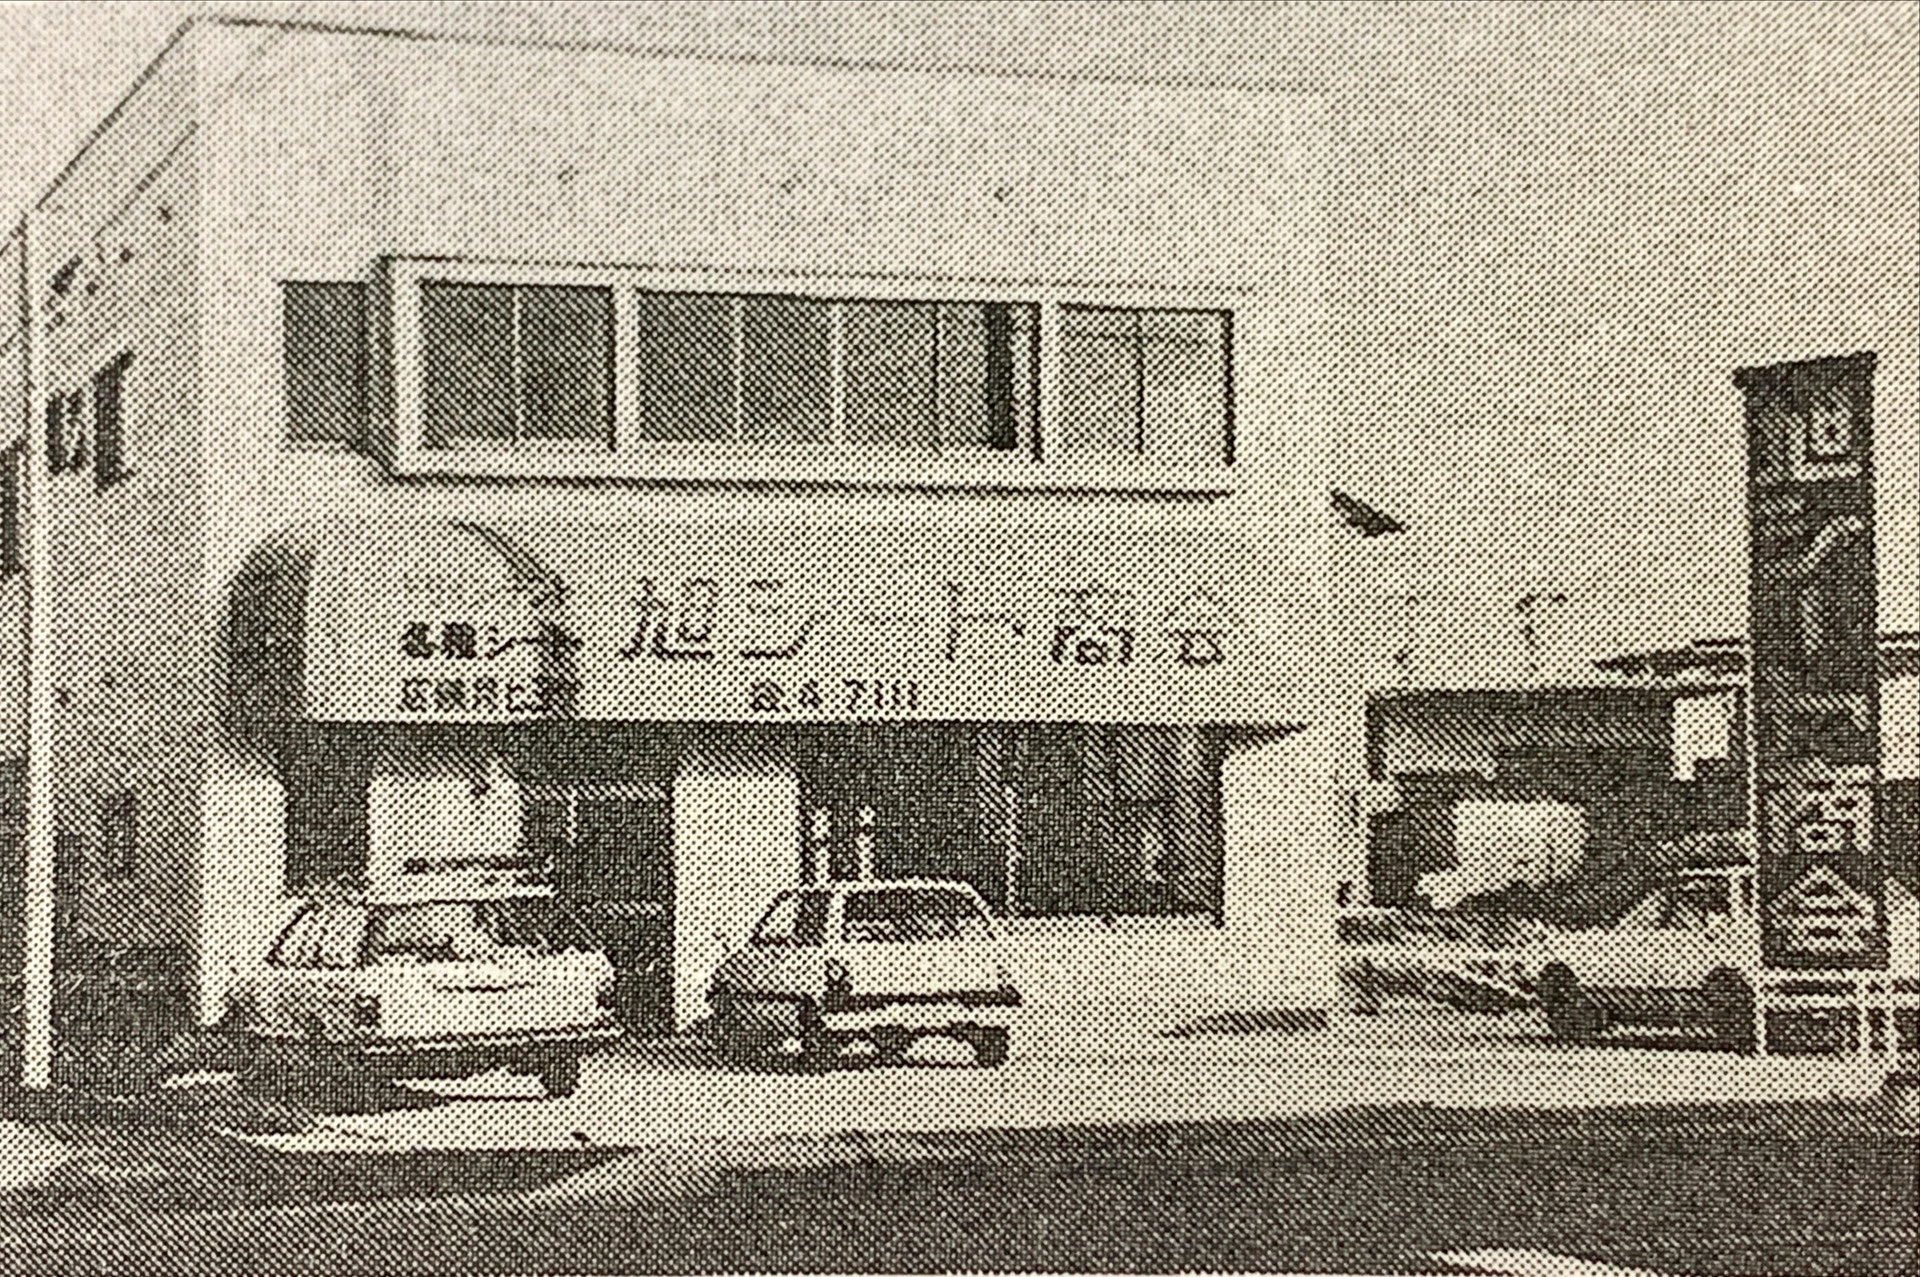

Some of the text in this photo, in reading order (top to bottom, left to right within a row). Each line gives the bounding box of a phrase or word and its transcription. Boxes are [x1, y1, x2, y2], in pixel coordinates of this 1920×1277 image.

[619, 576, 1244, 664] 旭シート商会
